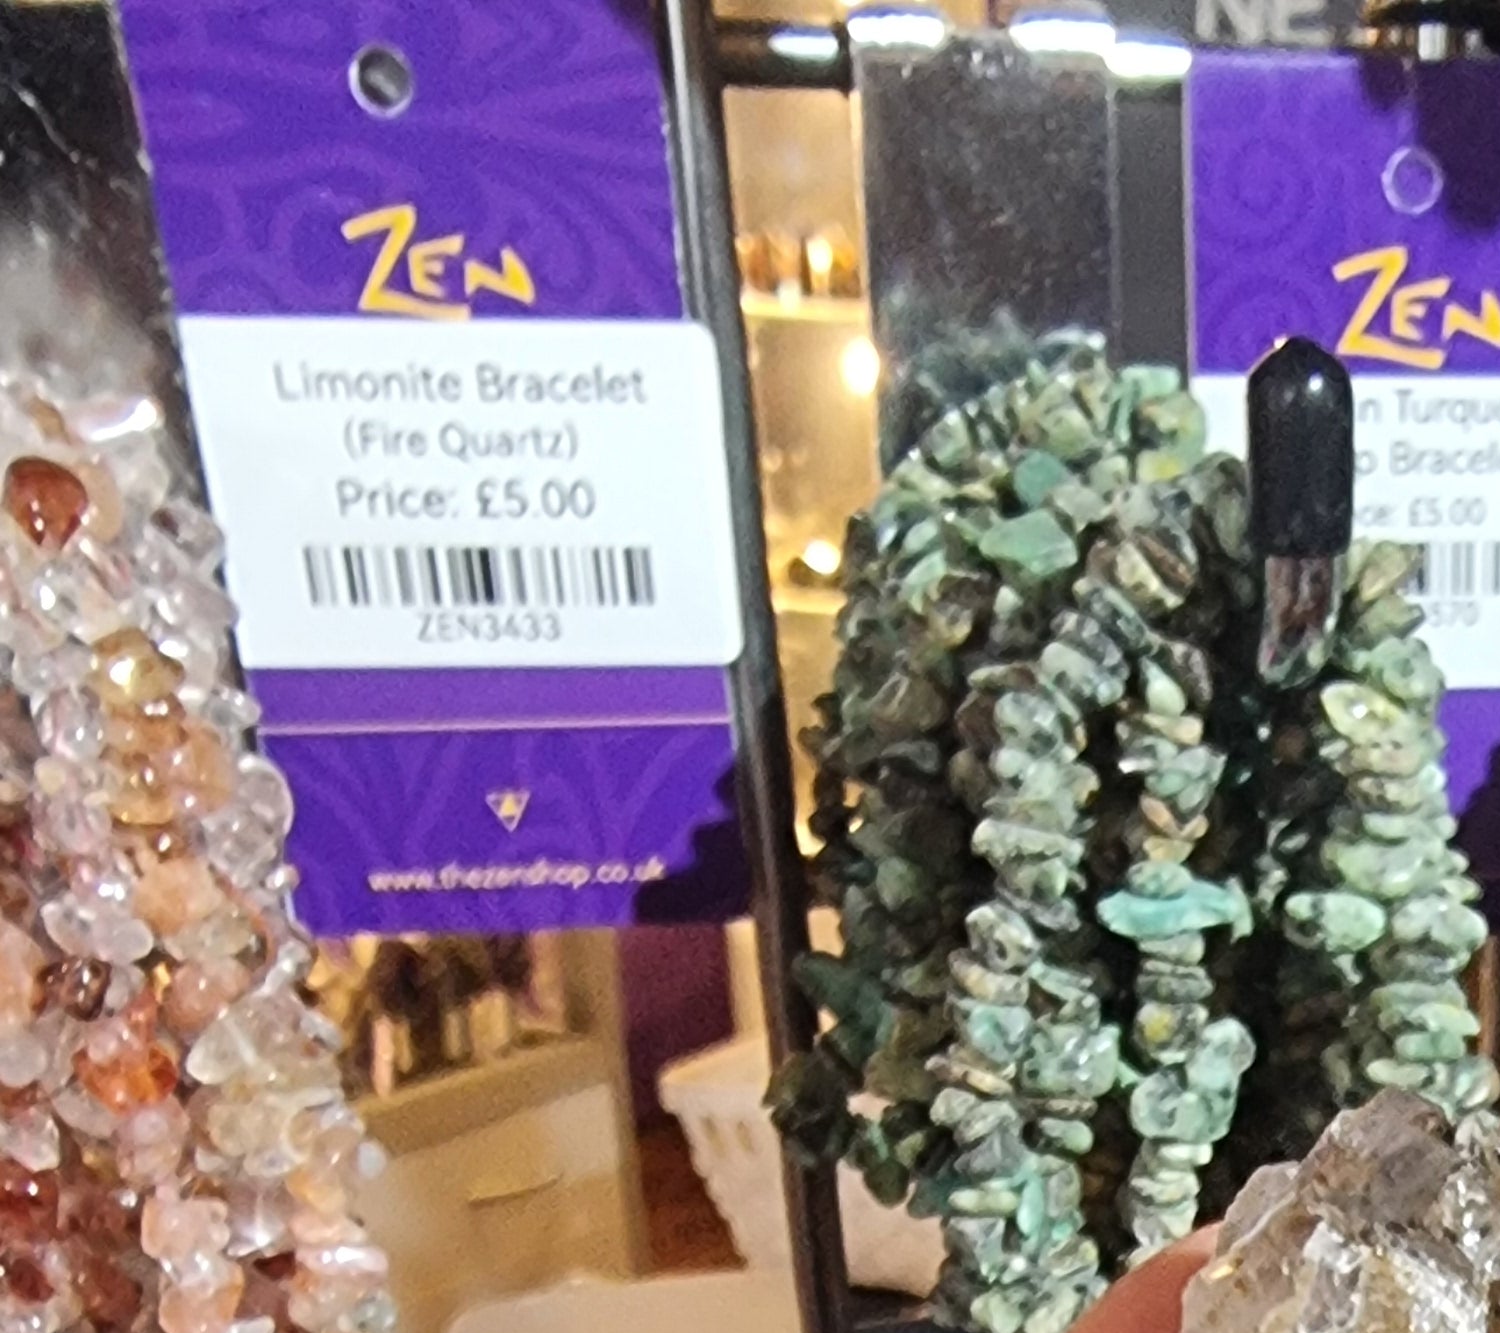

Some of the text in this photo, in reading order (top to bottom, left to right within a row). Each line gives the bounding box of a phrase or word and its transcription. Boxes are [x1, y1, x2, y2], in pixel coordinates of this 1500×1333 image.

[341, 204, 535, 320] ZEN
[273, 360, 648, 405] Limonite Bracelet
[342, 416, 580, 462] (Fire Quartz)
[335, 478, 597, 519] Price: £5.00
[1408, 496, 1488, 528] £5.00
[416, 612, 563, 643] ZEN3433
